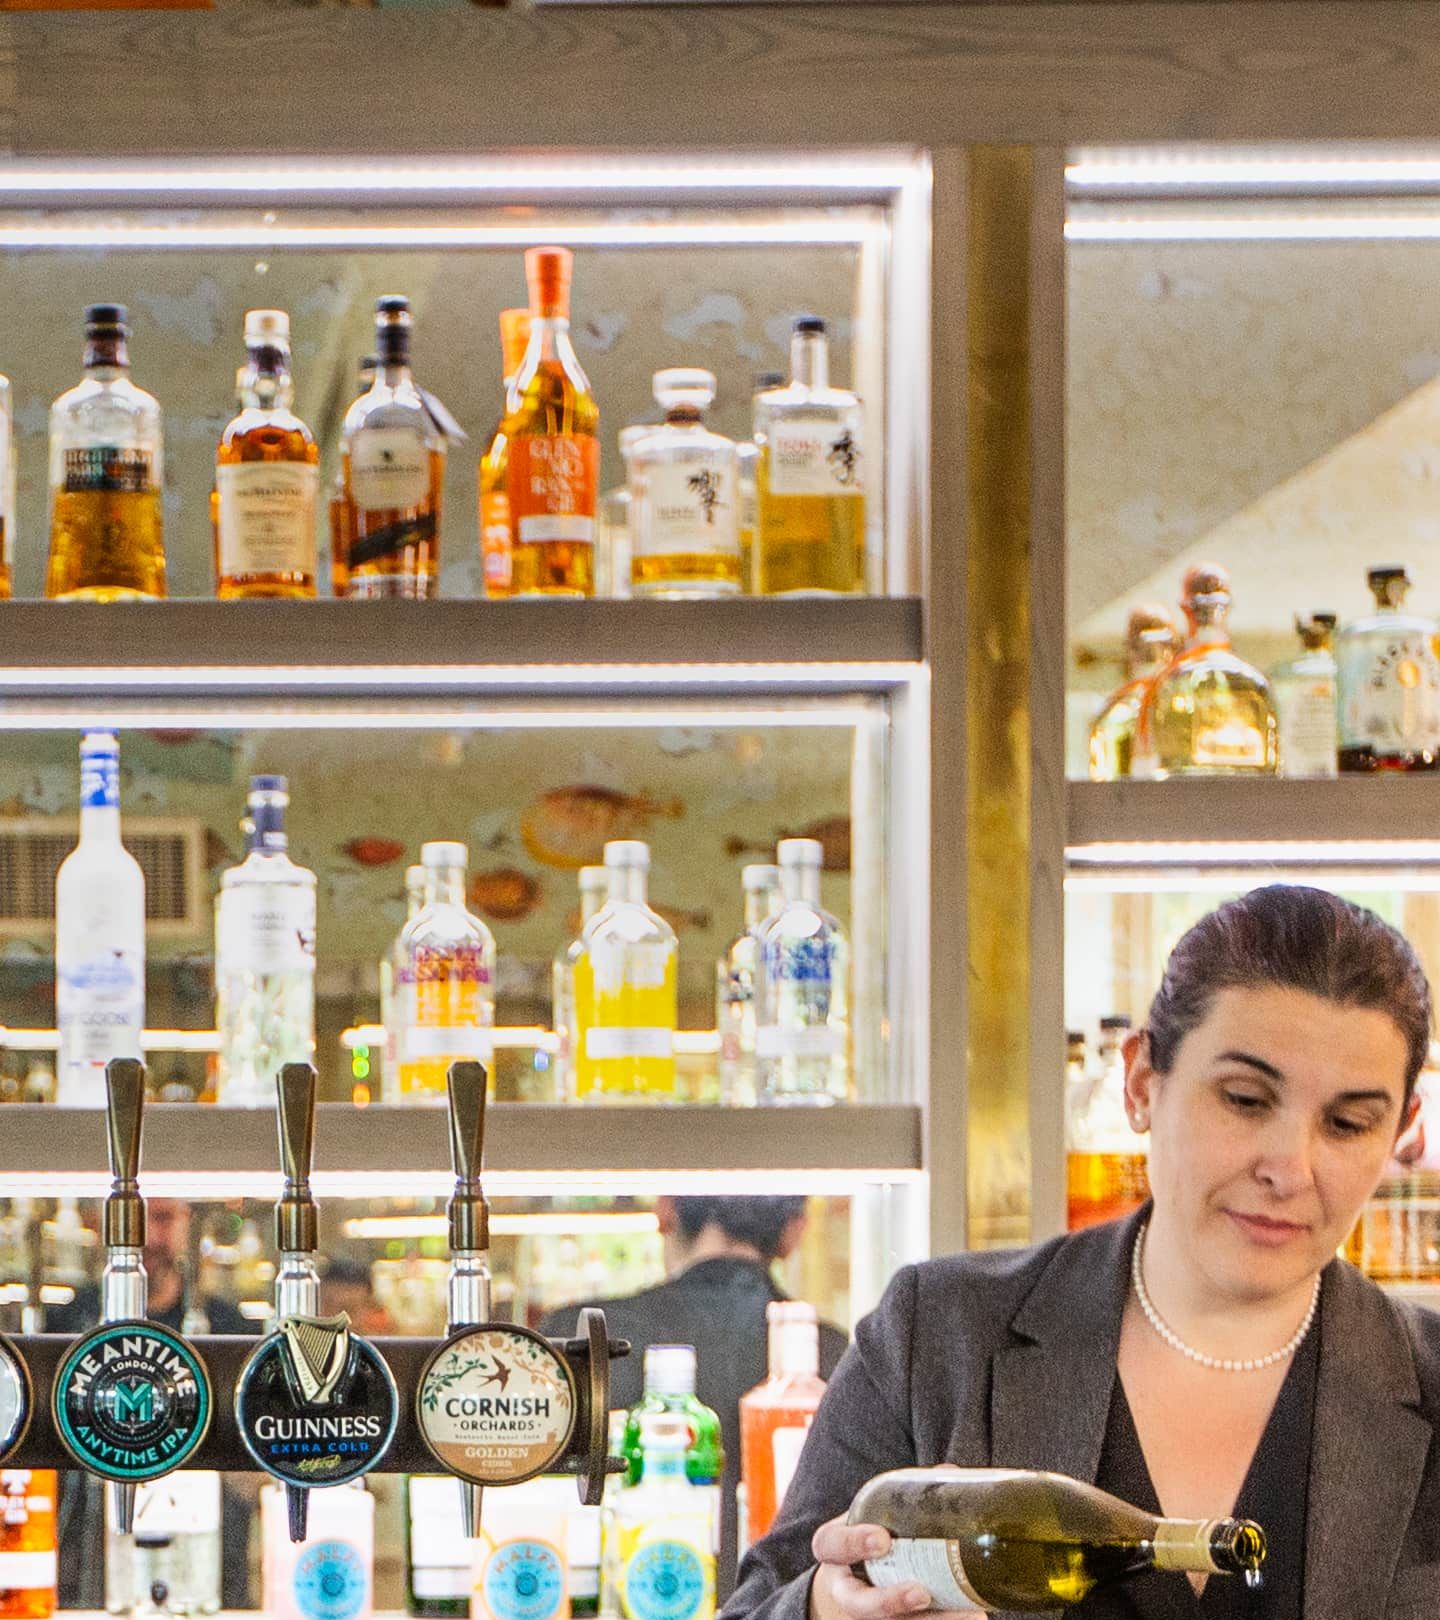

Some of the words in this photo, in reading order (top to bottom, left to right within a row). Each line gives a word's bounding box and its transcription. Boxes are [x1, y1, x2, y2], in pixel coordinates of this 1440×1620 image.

[70, 1336, 198, 1398] MEANTIME
[111, 1359, 156, 1374] LONDON
[445, 1397, 550, 1419] CORNISH
[254, 1415, 382, 1440] GUINNESS
[459, 1419, 535, 1431] ORCHARDS
[76, 1426, 160, 1465] ANYTIME
[160, 1427, 189, 1454] IPA
[270, 1442, 321, 1454] EXTRA
[327, 1441, 369, 1453] COLD
[464, 1446, 529, 1459] GOLDEN
